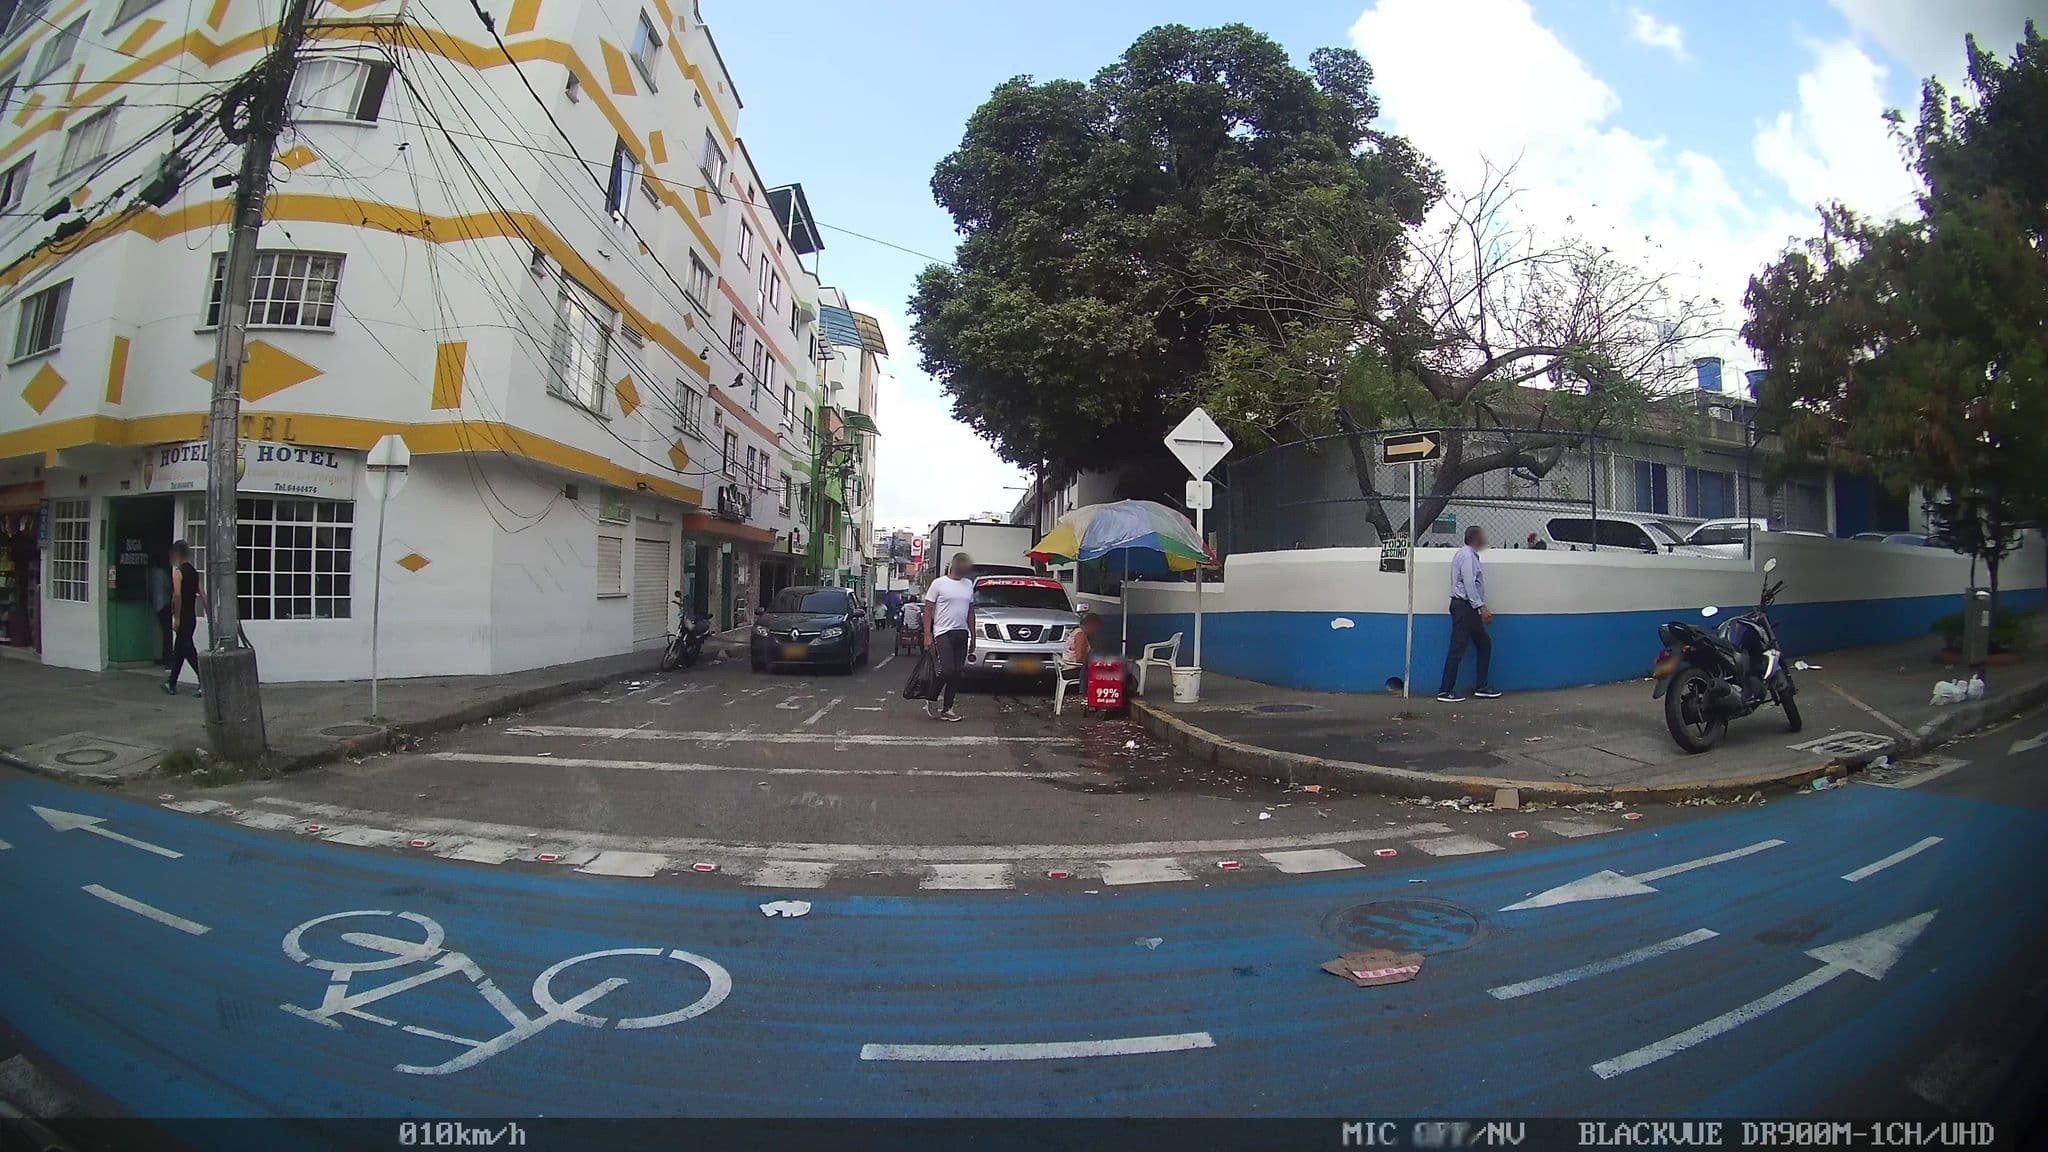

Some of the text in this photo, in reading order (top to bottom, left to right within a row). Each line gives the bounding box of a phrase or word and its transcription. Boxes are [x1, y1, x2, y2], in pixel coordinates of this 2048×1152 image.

[200, 415, 296, 441] HTEL
[160, 444, 208, 467] HOTEL
[257, 445, 338, 469] HOTEL
[1382, 539, 1407, 550] TODO
[120, 553, 148, 565] ABIERTO
[1096, 688, 1119, 698] 99%
